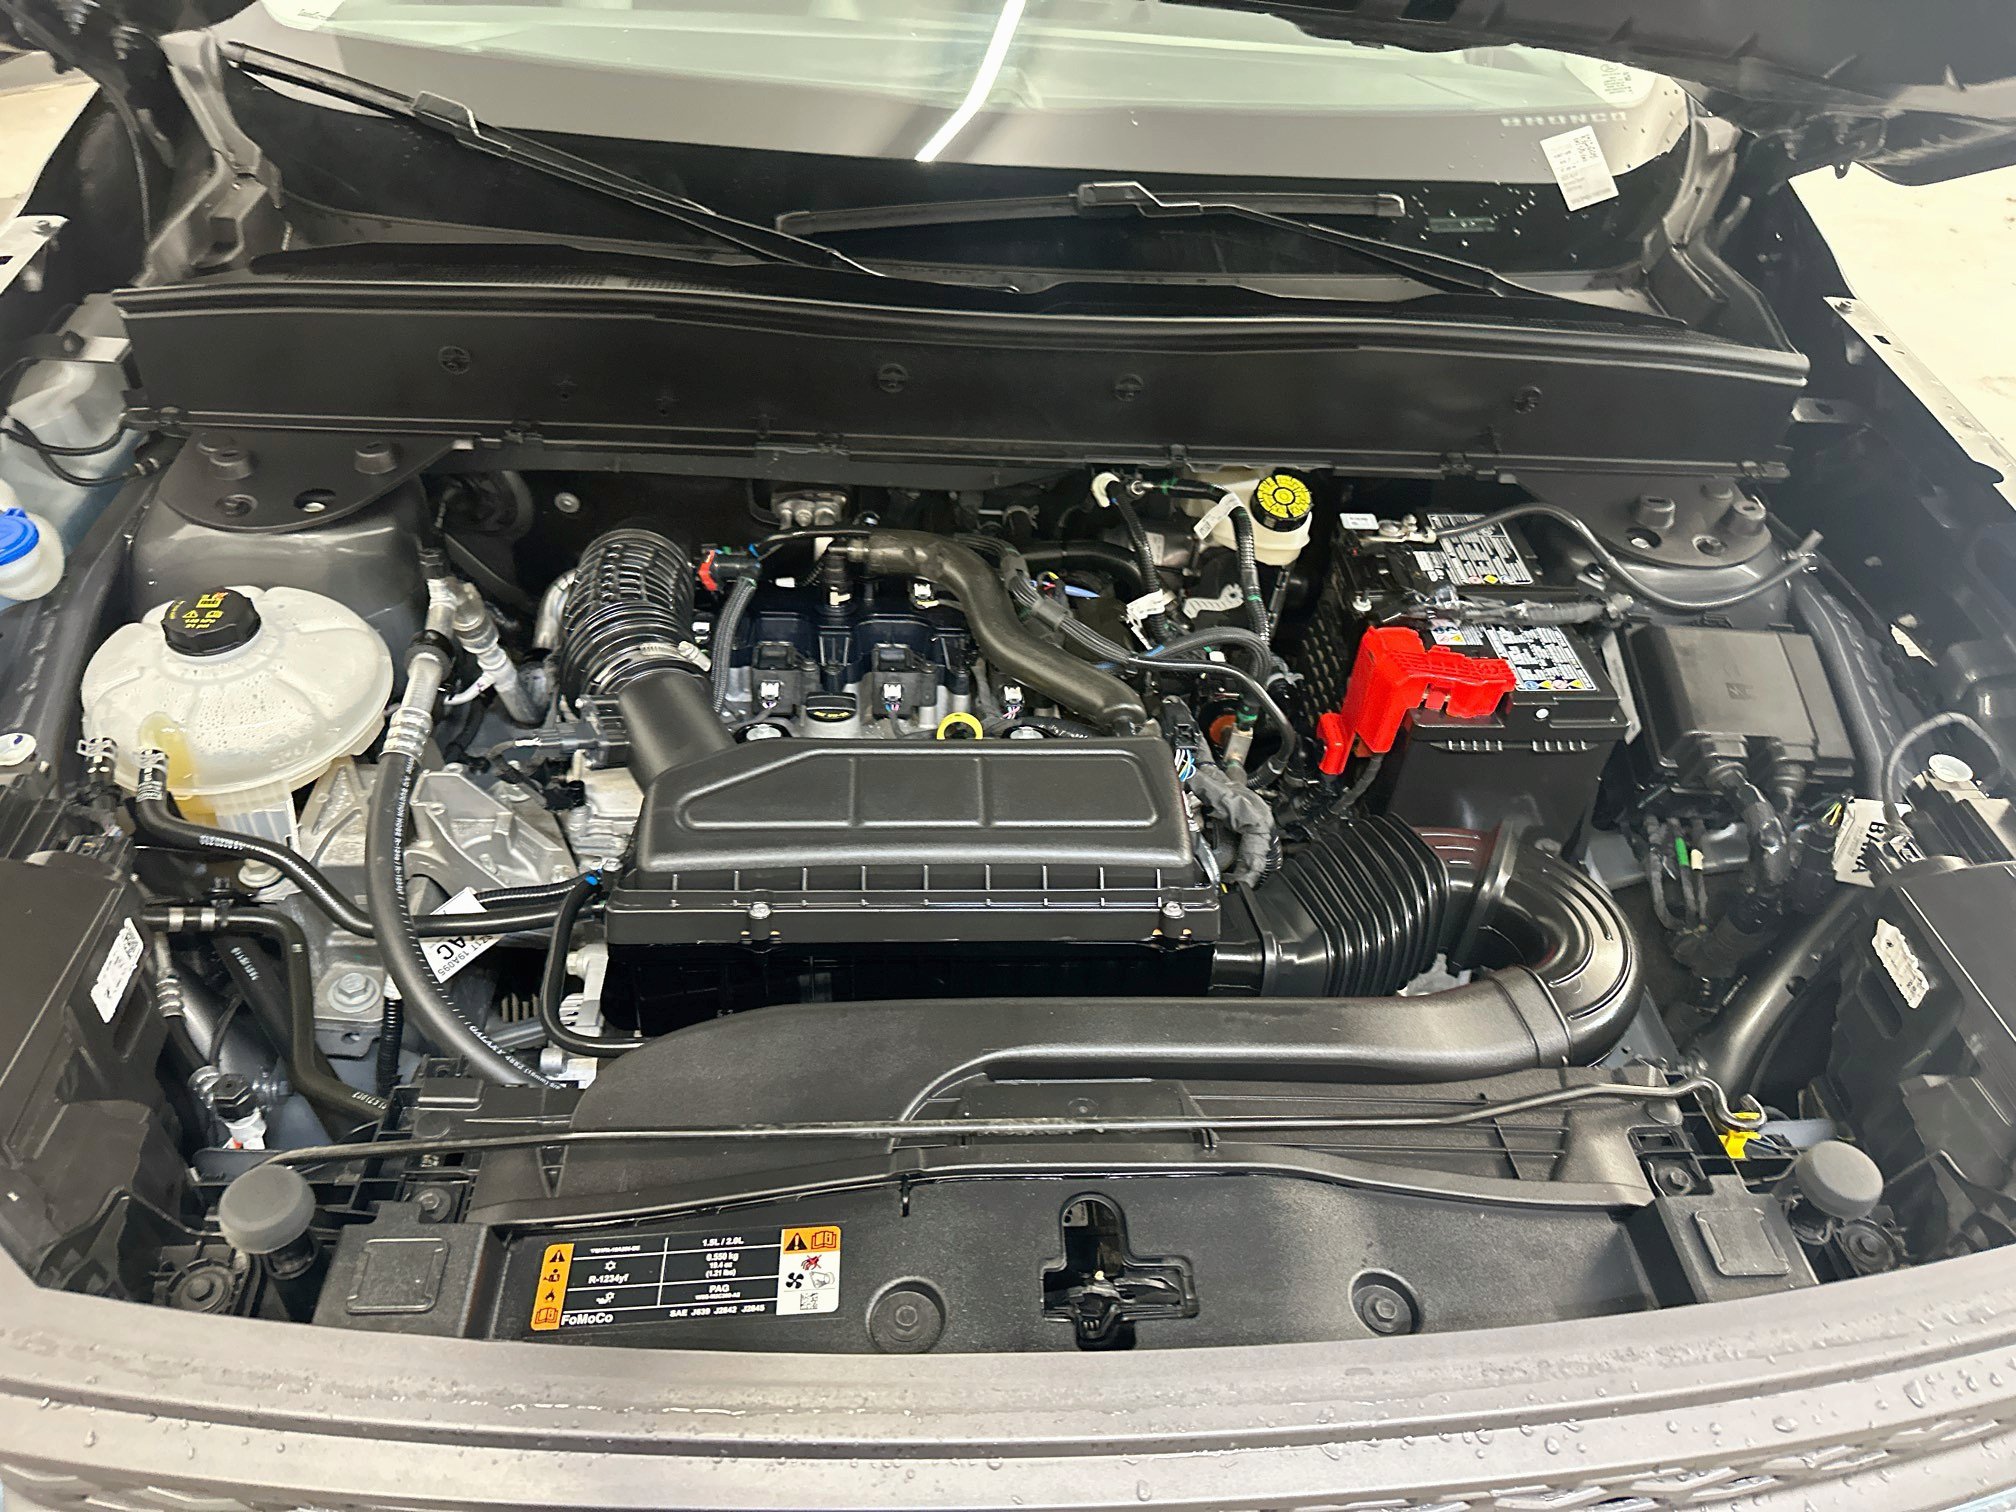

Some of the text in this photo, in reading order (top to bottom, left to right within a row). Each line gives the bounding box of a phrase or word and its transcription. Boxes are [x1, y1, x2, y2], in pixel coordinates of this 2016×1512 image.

[436, 936, 475, 960] AC
[437, 949, 470, 977] 19A095
[702, 1238, 720, 1247] 1.5L
[726, 1236, 745, 1246] 2.0L
[705, 1251, 740, 1262] 0.550 kg
[587, 1273, 630, 1285] R-1234yf
[708, 1284, 730, 1293] PAG
[669, 1304, 766, 1318] SAE J639 J2842 J2845
[560, 1312, 614, 1326] FoMoCo
